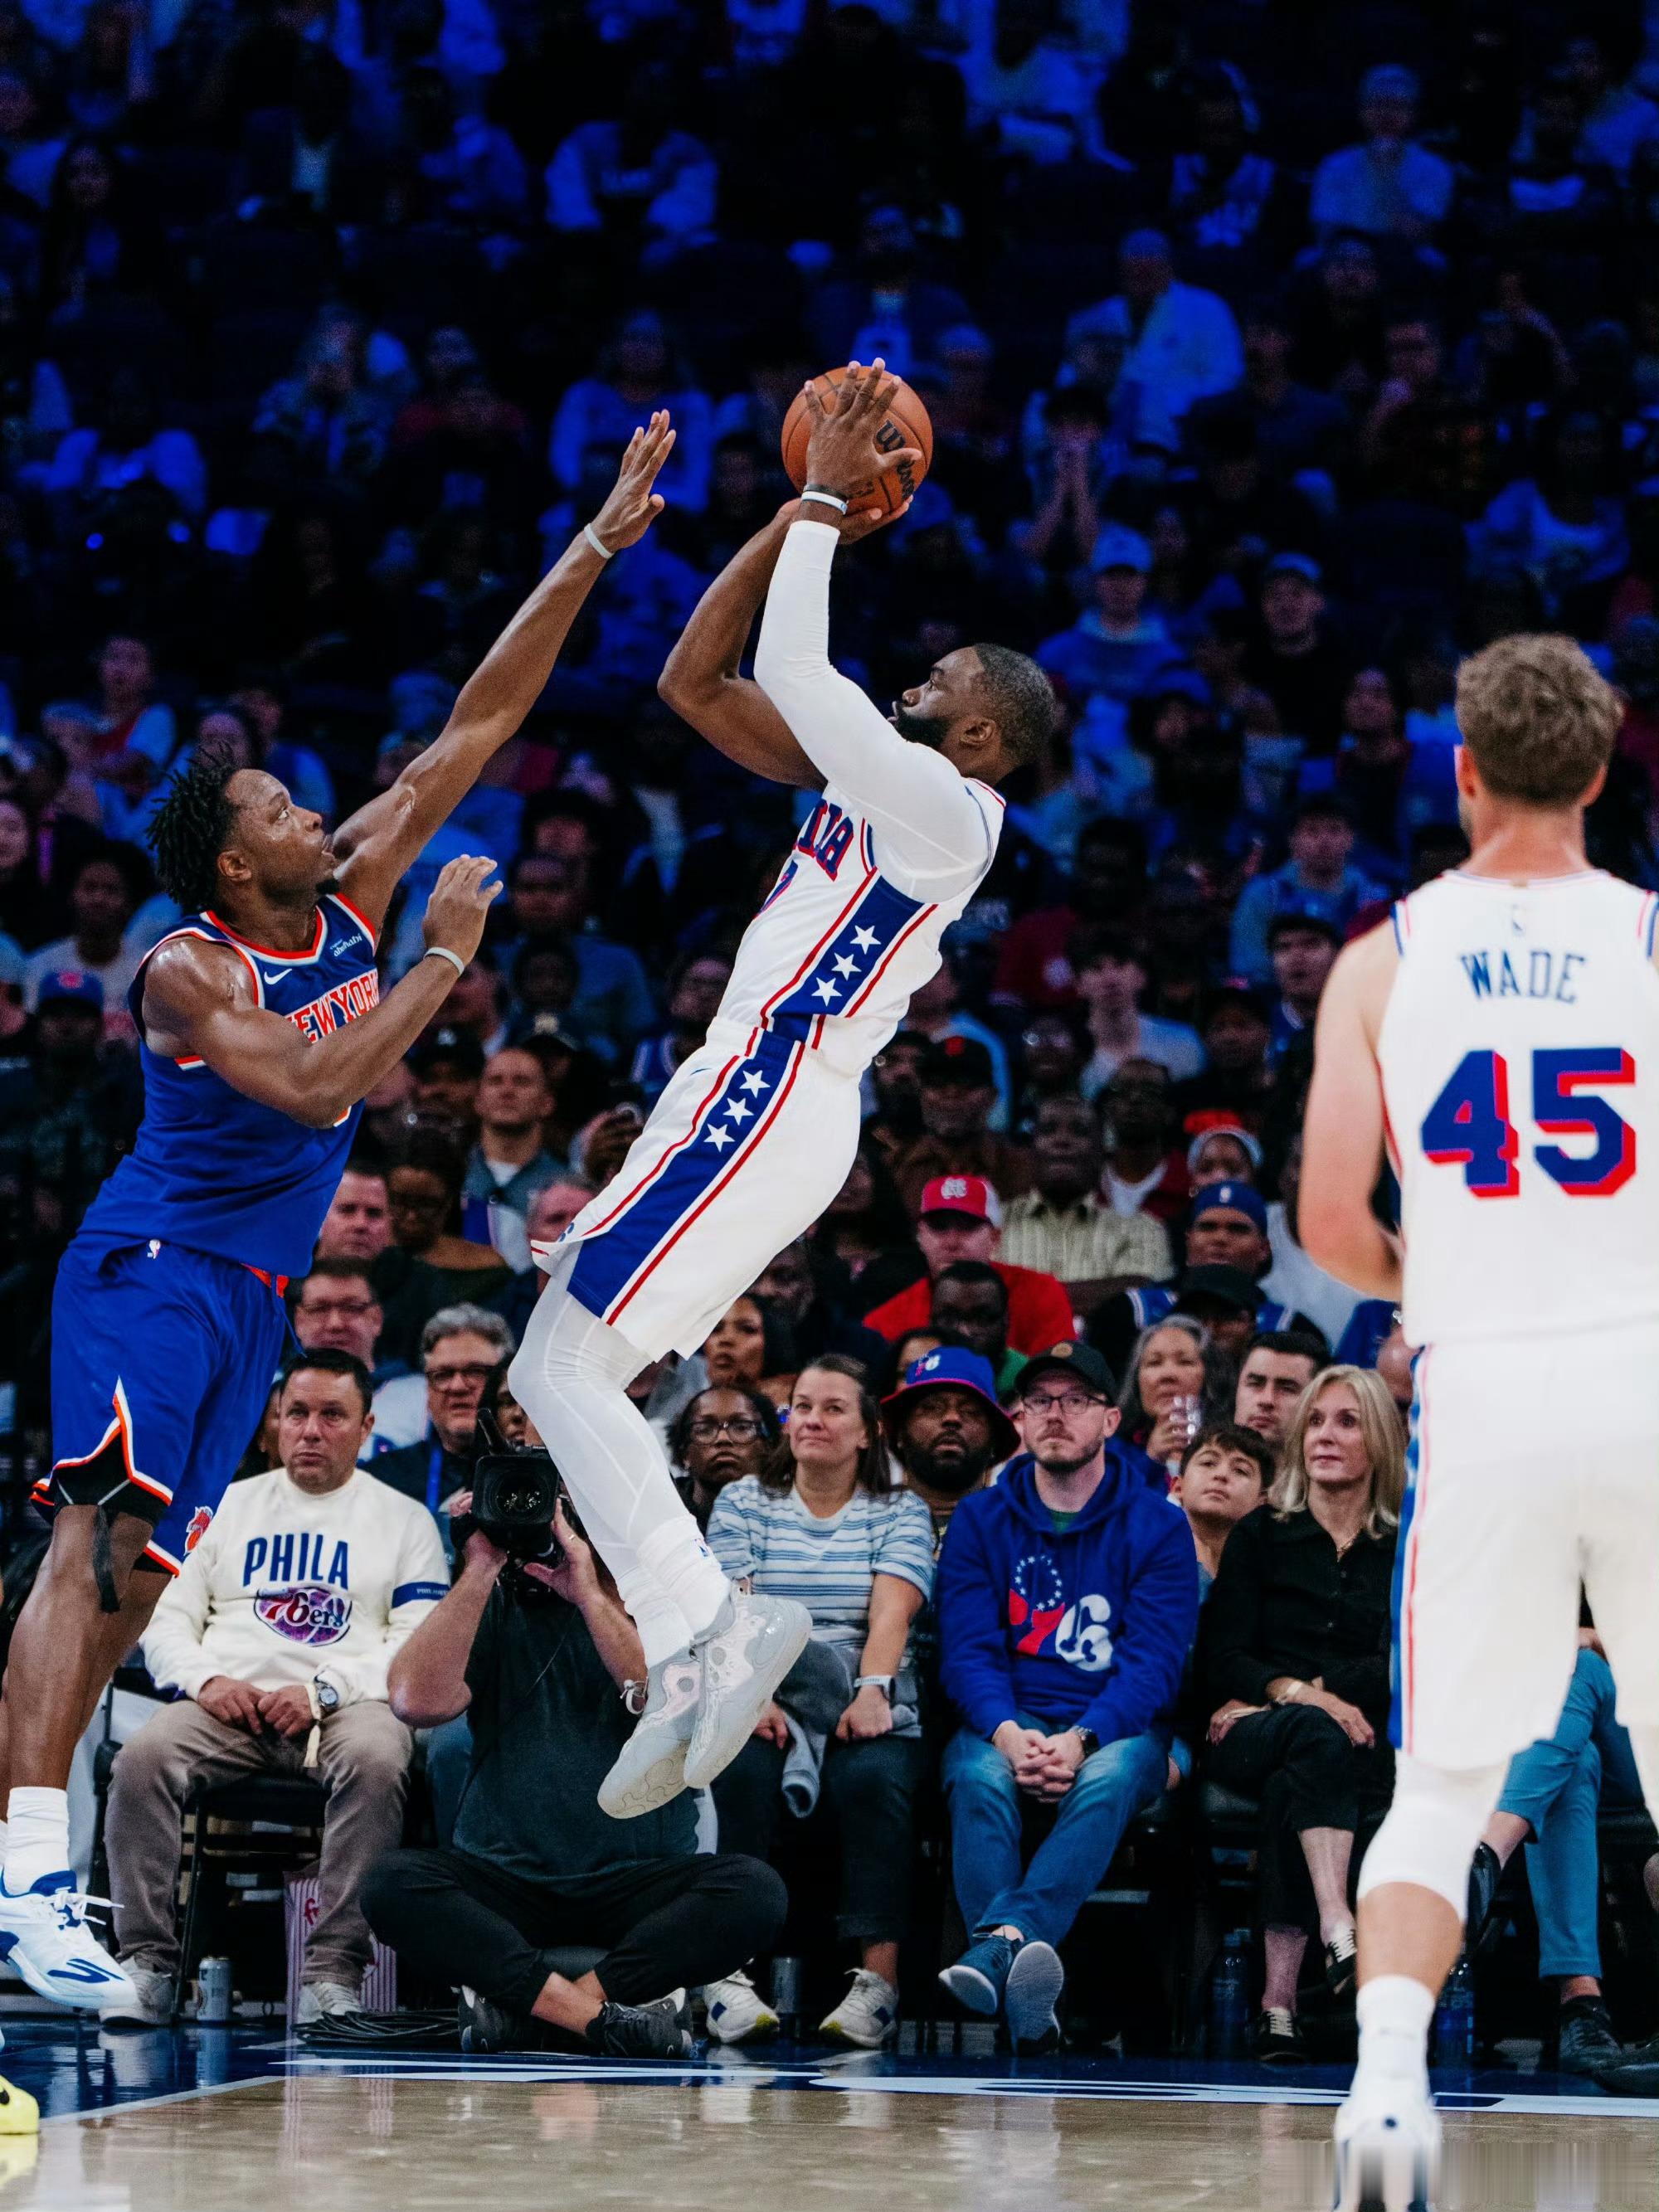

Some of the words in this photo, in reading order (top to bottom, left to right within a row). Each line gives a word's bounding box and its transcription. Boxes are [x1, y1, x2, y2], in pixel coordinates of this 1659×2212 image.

[1457, 949, 1587, 1004] WADE
[285, 994, 338, 1043] EW
[1420, 1046, 1637, 1199] 45
[242, 1532, 349, 1591] PHILA
[264, 1591, 344, 1627] 76ers
[1008, 1588, 1113, 1672] 76
